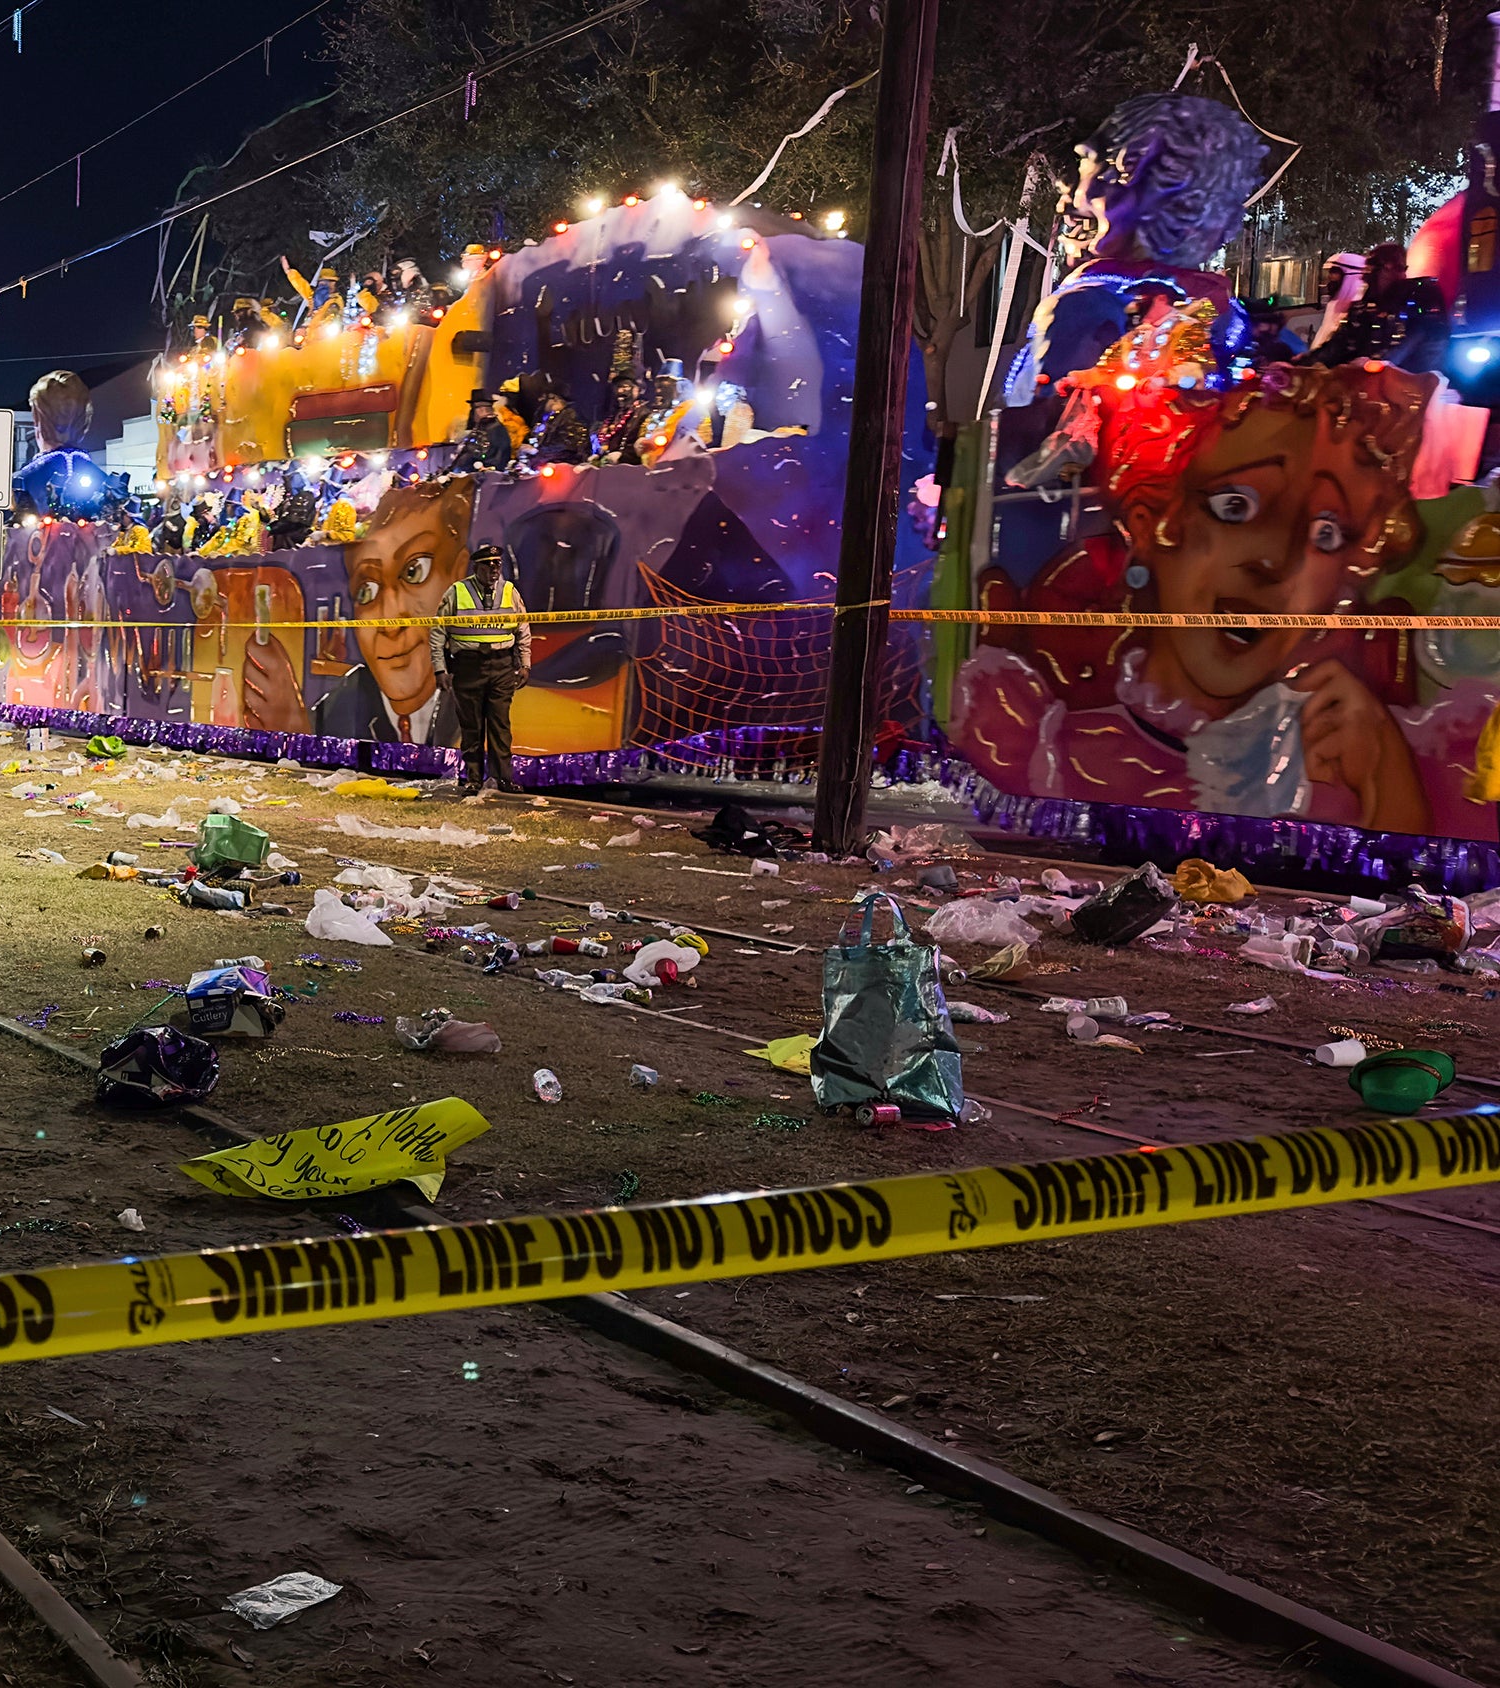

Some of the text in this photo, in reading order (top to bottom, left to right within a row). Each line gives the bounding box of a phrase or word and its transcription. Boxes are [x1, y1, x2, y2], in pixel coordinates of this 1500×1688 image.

[192, 1011, 228, 1023] Cutlery
[995, 1149, 1173, 1230] SHERIFF
[1178, 1138, 1277, 1207] LINE
[1270, 1126, 1340, 1196] DO
[1344, 1120, 1419, 1187] NOT
[199, 1232, 414, 1324] SHERIFF
[424, 1220, 543, 1297] LINE
[550, 1212, 623, 1283] DO
[627, 1202, 725, 1274] NOT
[737, 1184, 892, 1261] CROSS
